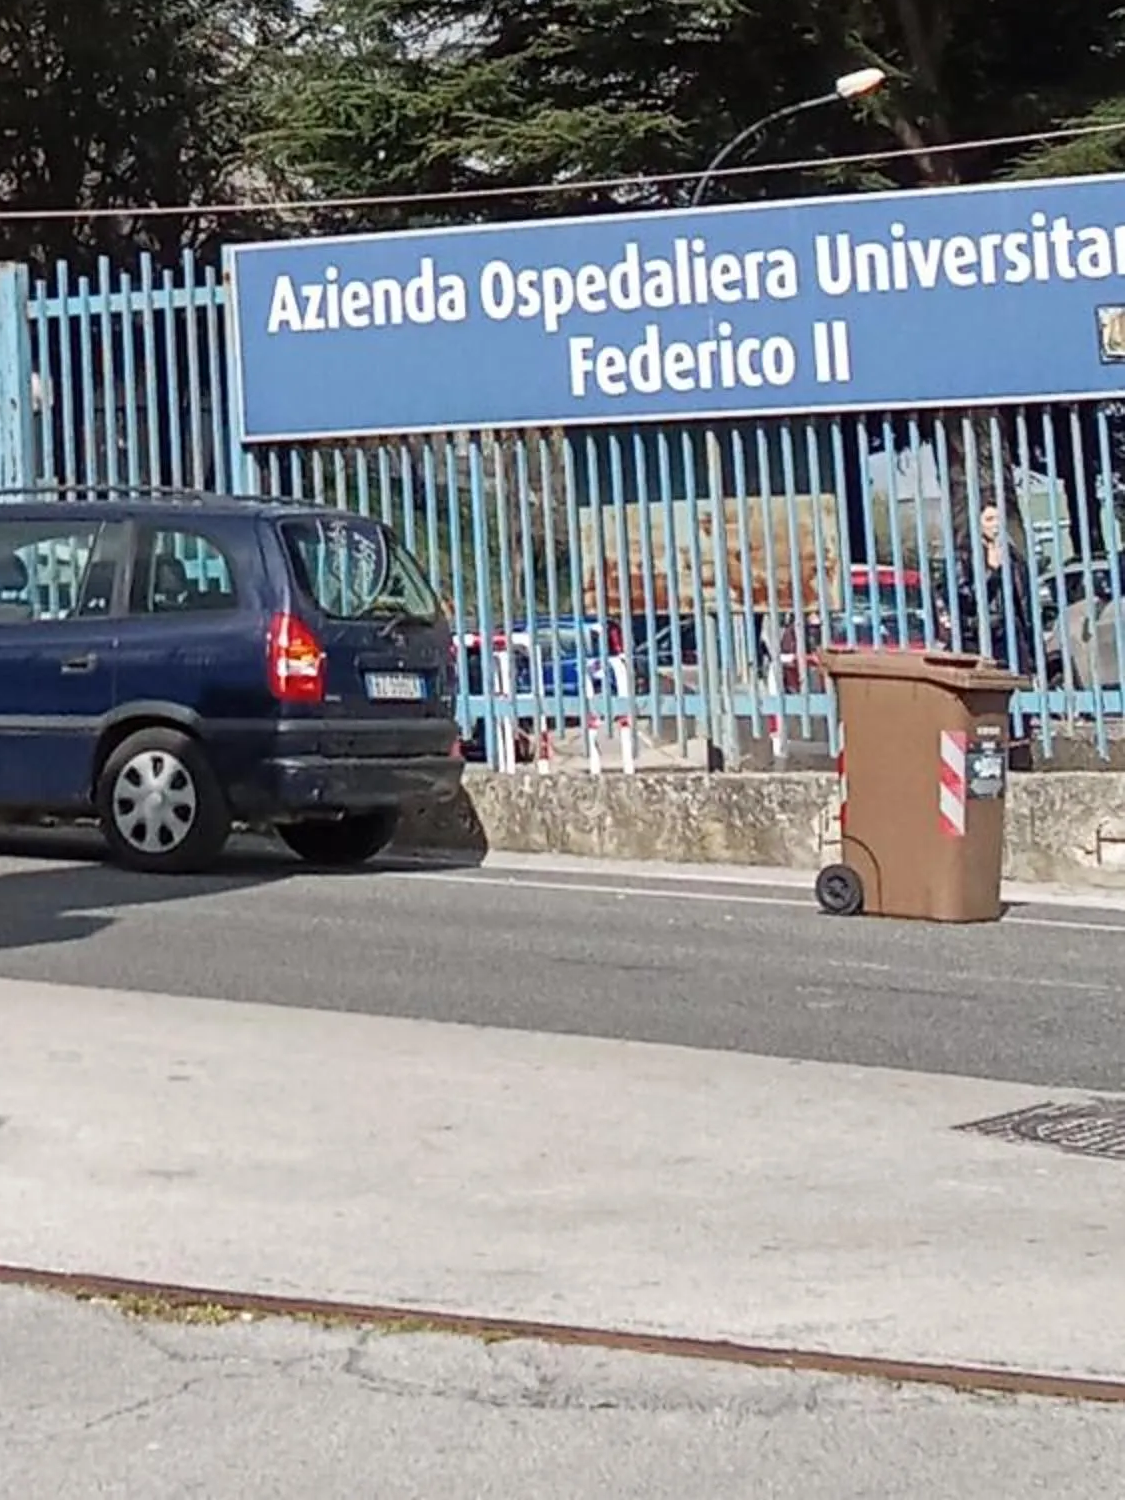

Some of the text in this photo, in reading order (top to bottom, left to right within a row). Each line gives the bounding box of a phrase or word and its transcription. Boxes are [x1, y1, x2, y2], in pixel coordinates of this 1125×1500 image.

[267, 257, 467, 334] Azienda
[480, 237, 797, 332] Ospedaliera
[568, 320, 851, 397] Federico II
